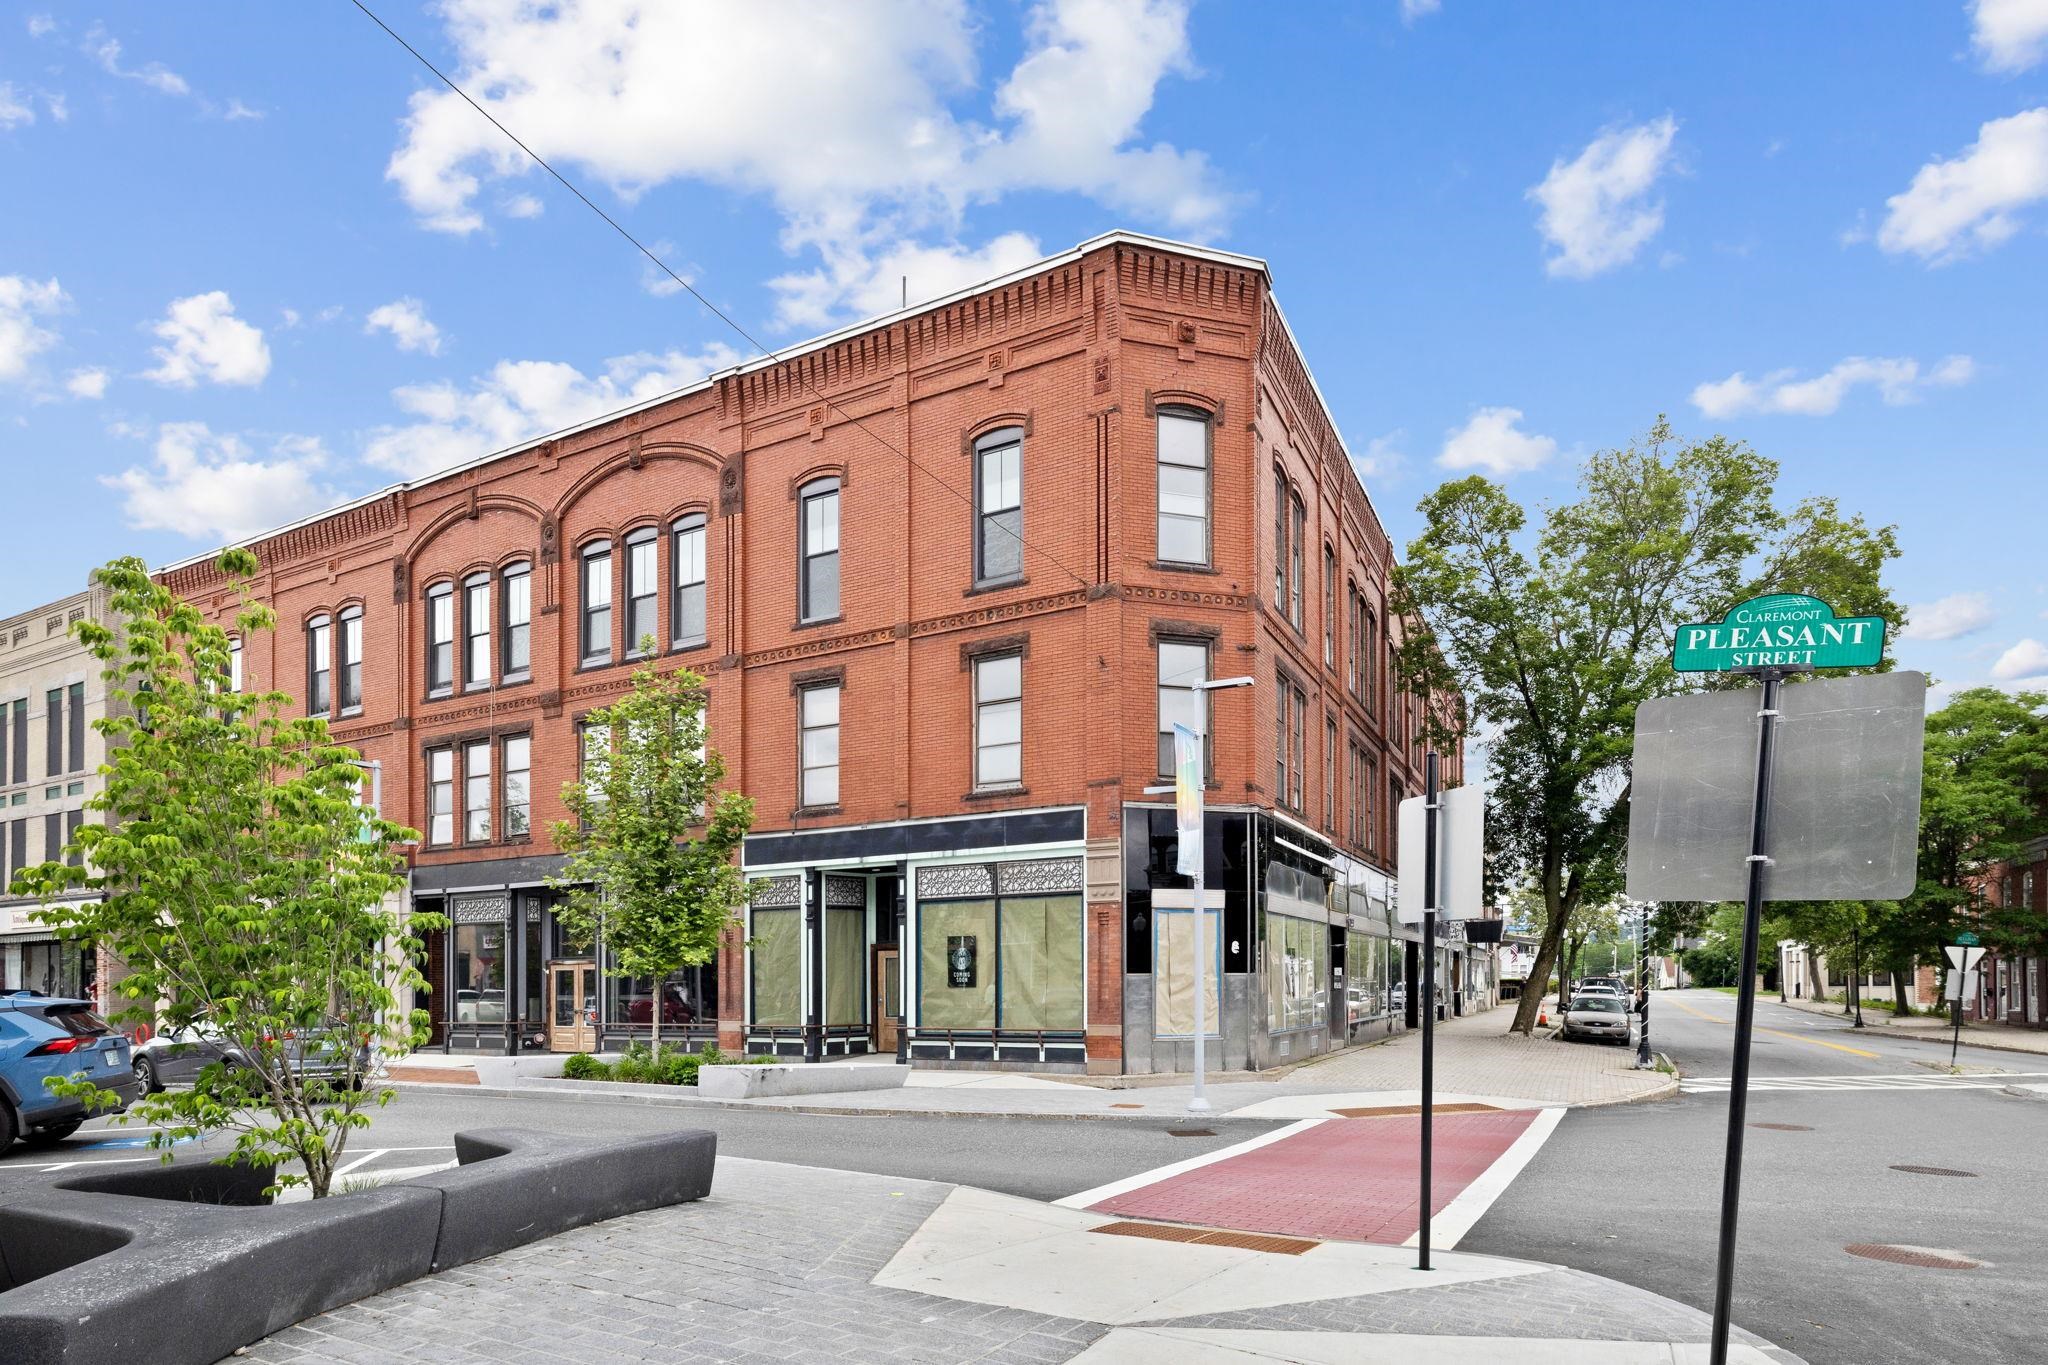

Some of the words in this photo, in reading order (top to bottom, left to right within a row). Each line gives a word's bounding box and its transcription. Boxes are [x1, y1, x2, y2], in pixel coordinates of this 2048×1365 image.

[1736, 610, 1822, 624] CLAREMONT
[1687, 622, 1872, 650] PLEASANT
[1732, 650, 1816, 666] STREET
